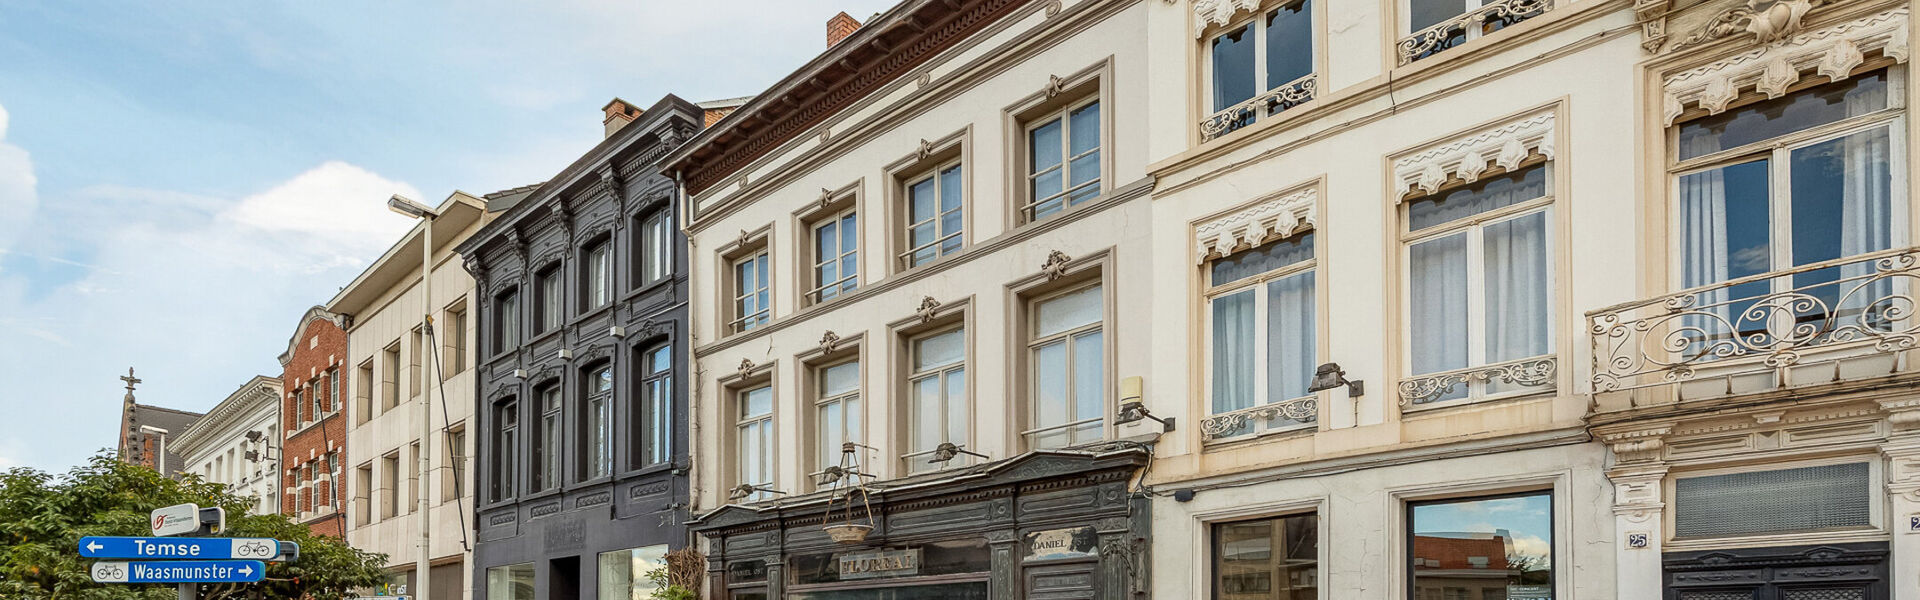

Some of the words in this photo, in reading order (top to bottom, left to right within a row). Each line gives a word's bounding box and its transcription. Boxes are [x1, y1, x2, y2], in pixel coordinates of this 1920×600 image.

[1033, 539, 1067, 550] DANIEL
[1630, 534, 1645, 546] 25
[134, 540, 201, 556] Temse
[134, 564, 233, 579] Waasmunster
[840, 555, 914, 575] FLOREAL
